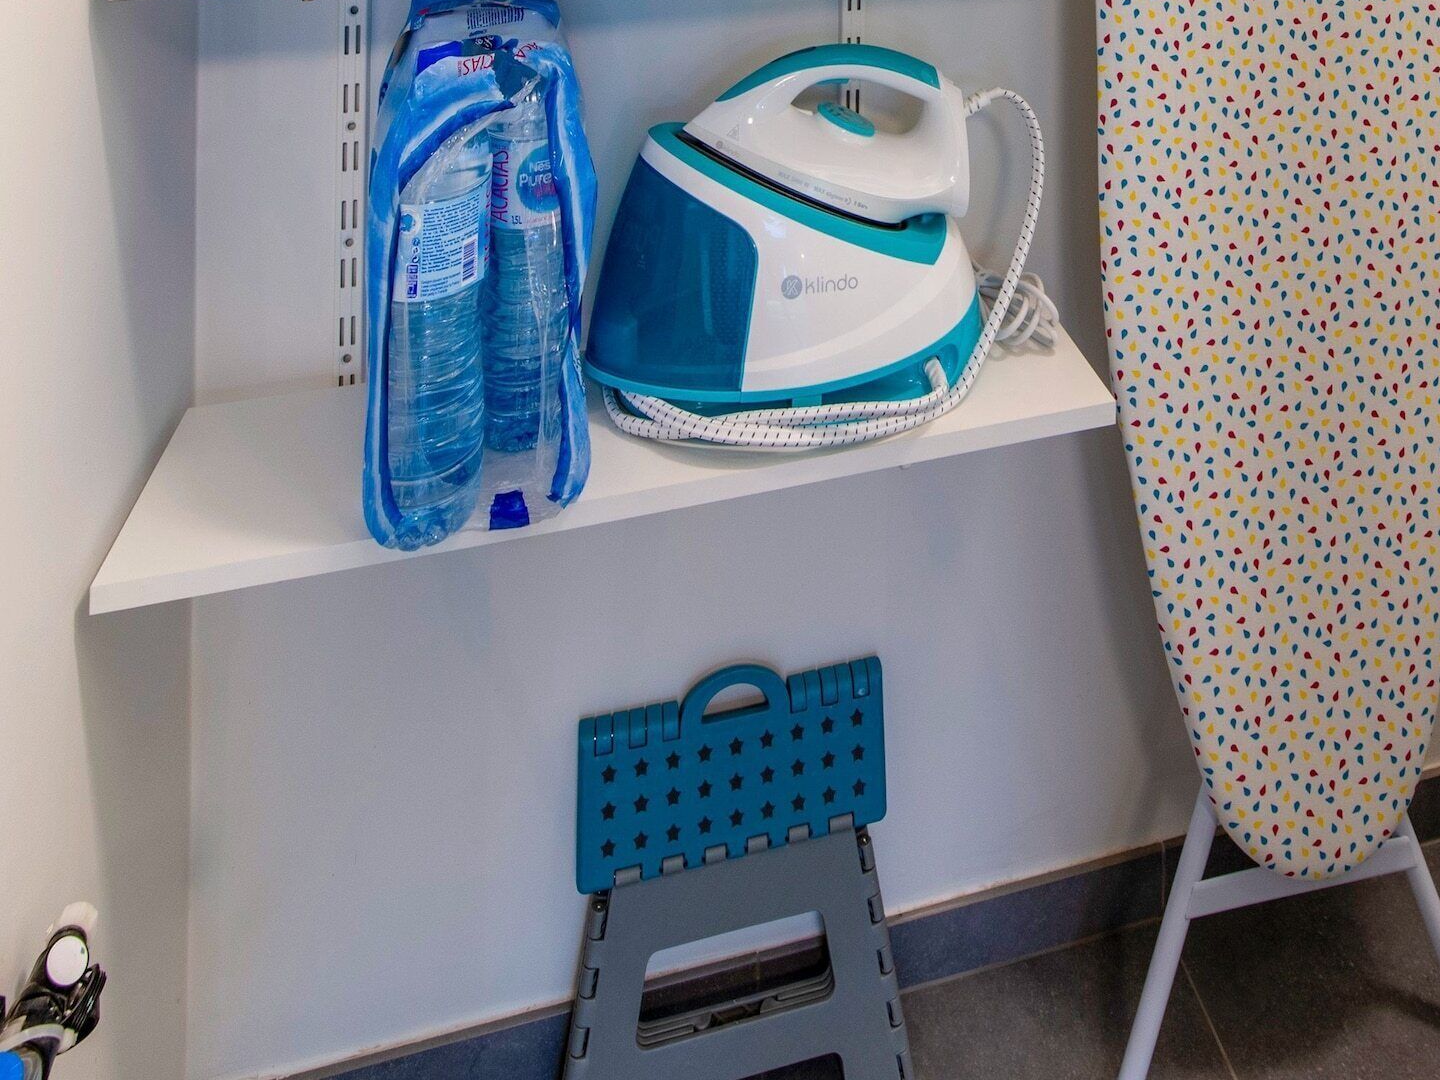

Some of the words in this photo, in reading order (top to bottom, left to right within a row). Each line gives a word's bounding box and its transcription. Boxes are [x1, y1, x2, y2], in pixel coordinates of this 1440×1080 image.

[529, 160, 551, 173] Nes
[491, 150, 509, 223] ACACIAS
[805, 274, 859, 295] klindo
